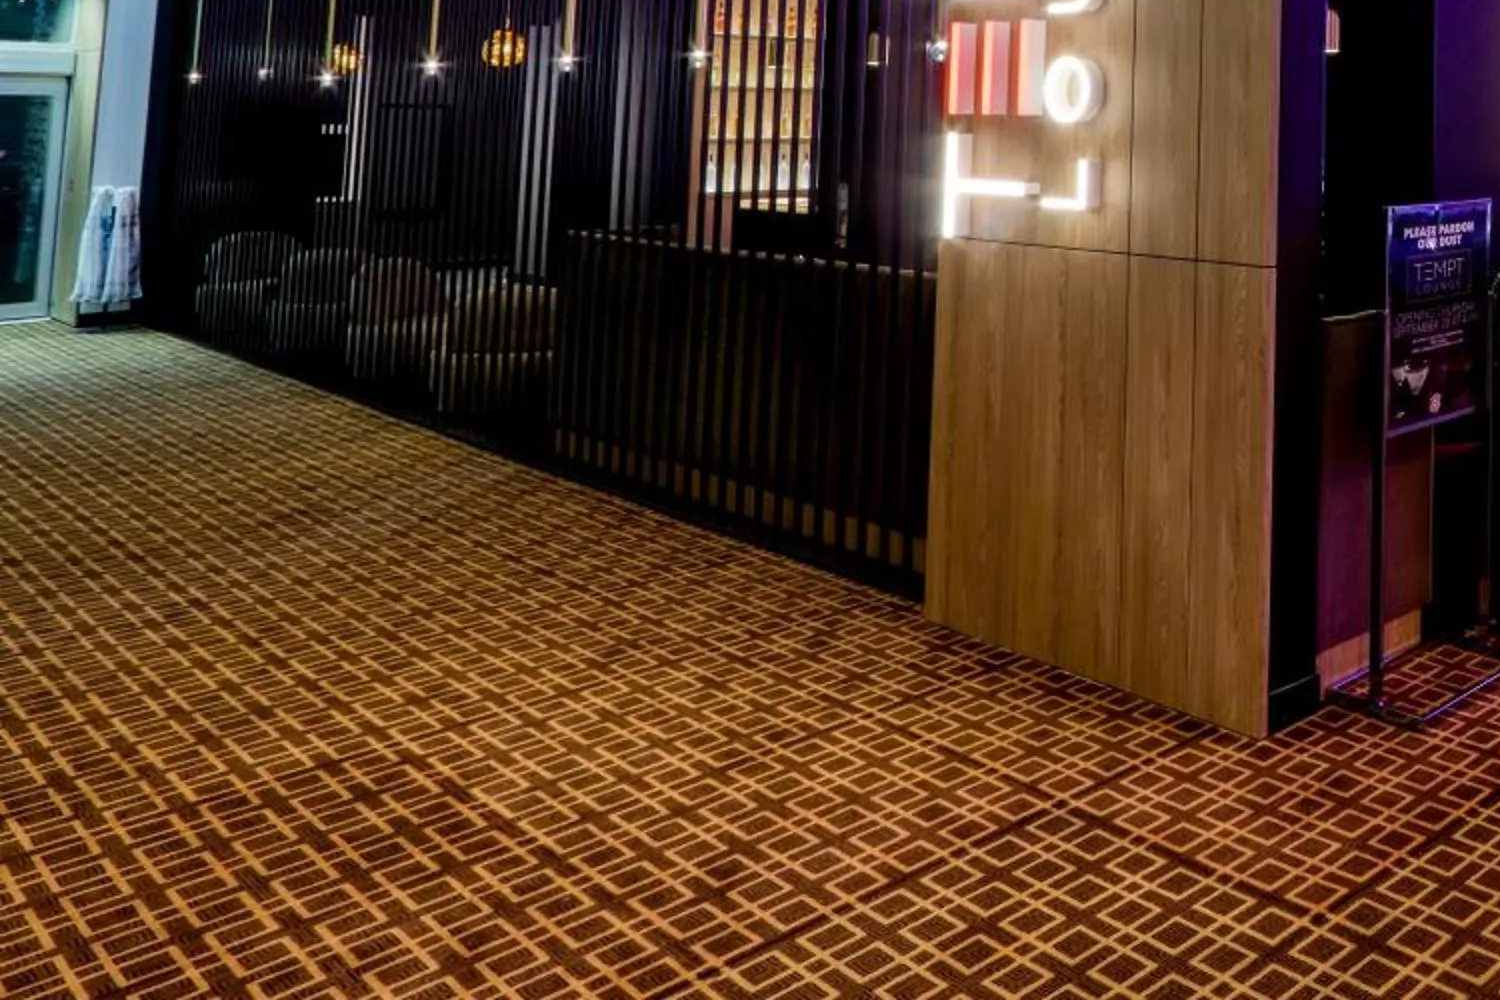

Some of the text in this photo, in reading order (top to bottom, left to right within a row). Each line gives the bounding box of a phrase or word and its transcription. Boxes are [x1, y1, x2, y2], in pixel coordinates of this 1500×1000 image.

[1403, 220, 1476, 241] PLEASE PARDON
[1439, 233, 1464, 248] DUST
[1412, 257, 1466, 283] TEMPT
[1415, 279, 1463, 297] LOUNGE
